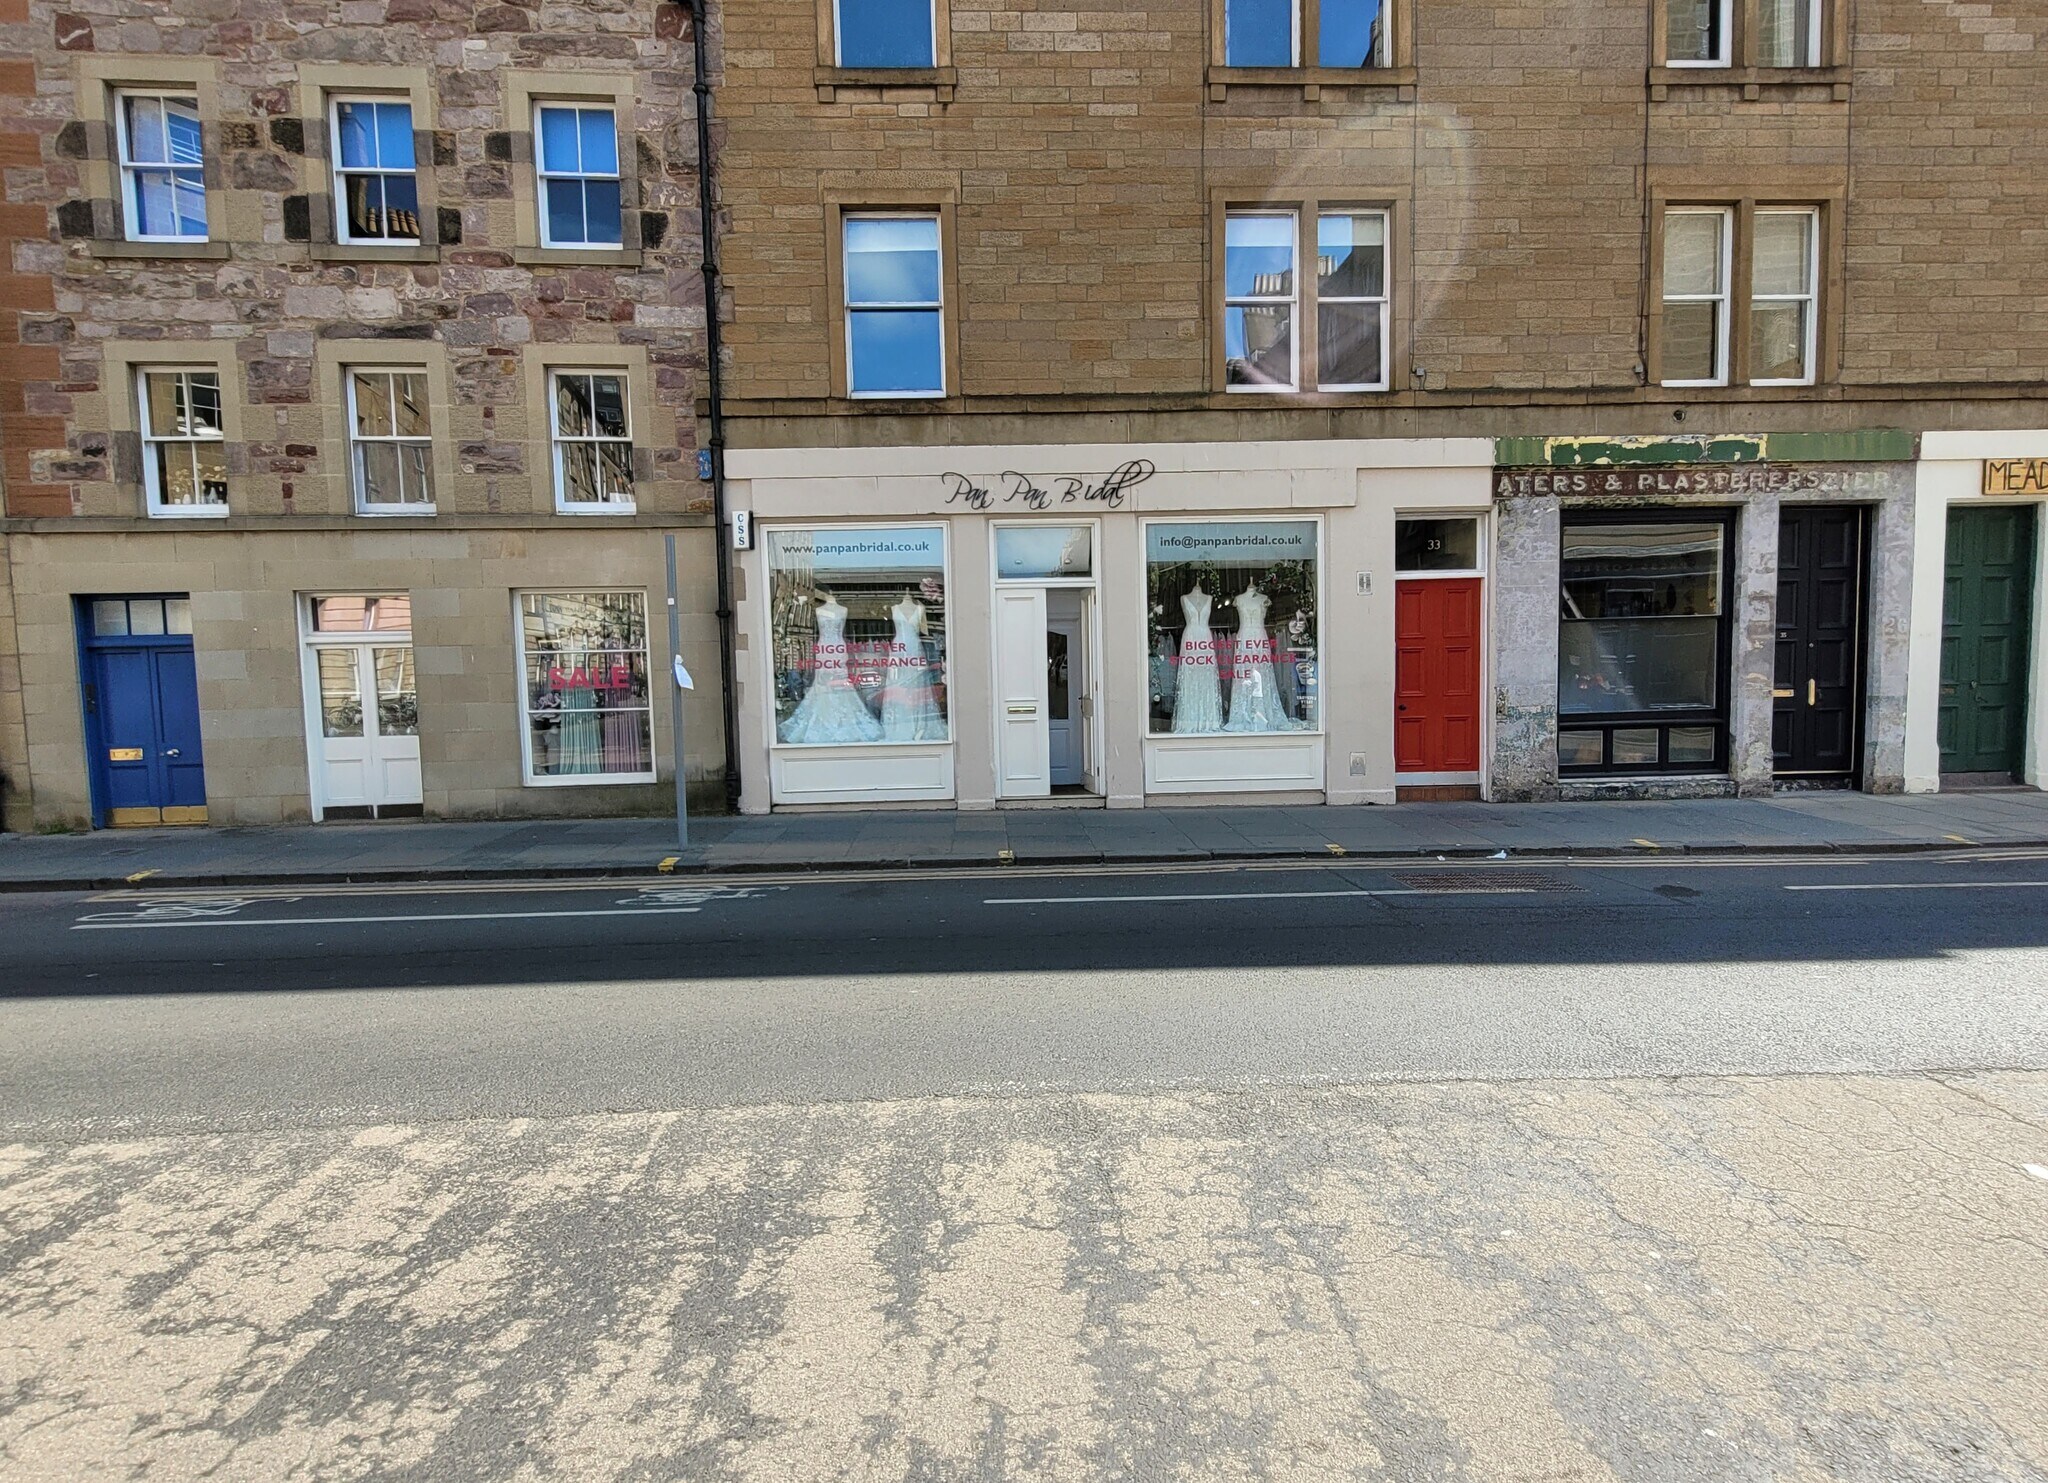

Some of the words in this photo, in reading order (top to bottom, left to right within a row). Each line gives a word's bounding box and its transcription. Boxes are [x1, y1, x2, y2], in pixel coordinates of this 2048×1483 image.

[1604, 474, 1623, 491] &
[942, 472, 995, 510] Pan
[1001, 470, 1053, 510] Pan
[782, 541, 930, 556] www.panpanbridal.co.uk
[1159, 535, 1303, 549] info@panpanbridal.co.uk
[1427, 539, 1441, 550] 33
[812, 643, 870, 655] BIGGEST
[874, 642, 906, 653] EVER
[1185, 639, 1241, 651] BIGGEST
[1245, 639, 1277, 649] EVER
[796, 658, 842, 670] STOCK
[845, 657, 927, 669] CLEARANCE
[1169, 655, 1215, 666] STOCK
[1217, 653, 1296, 665] CLEARANCE
[549, 665, 630, 690] SALE
[1219, 669, 1251, 680] SALE
